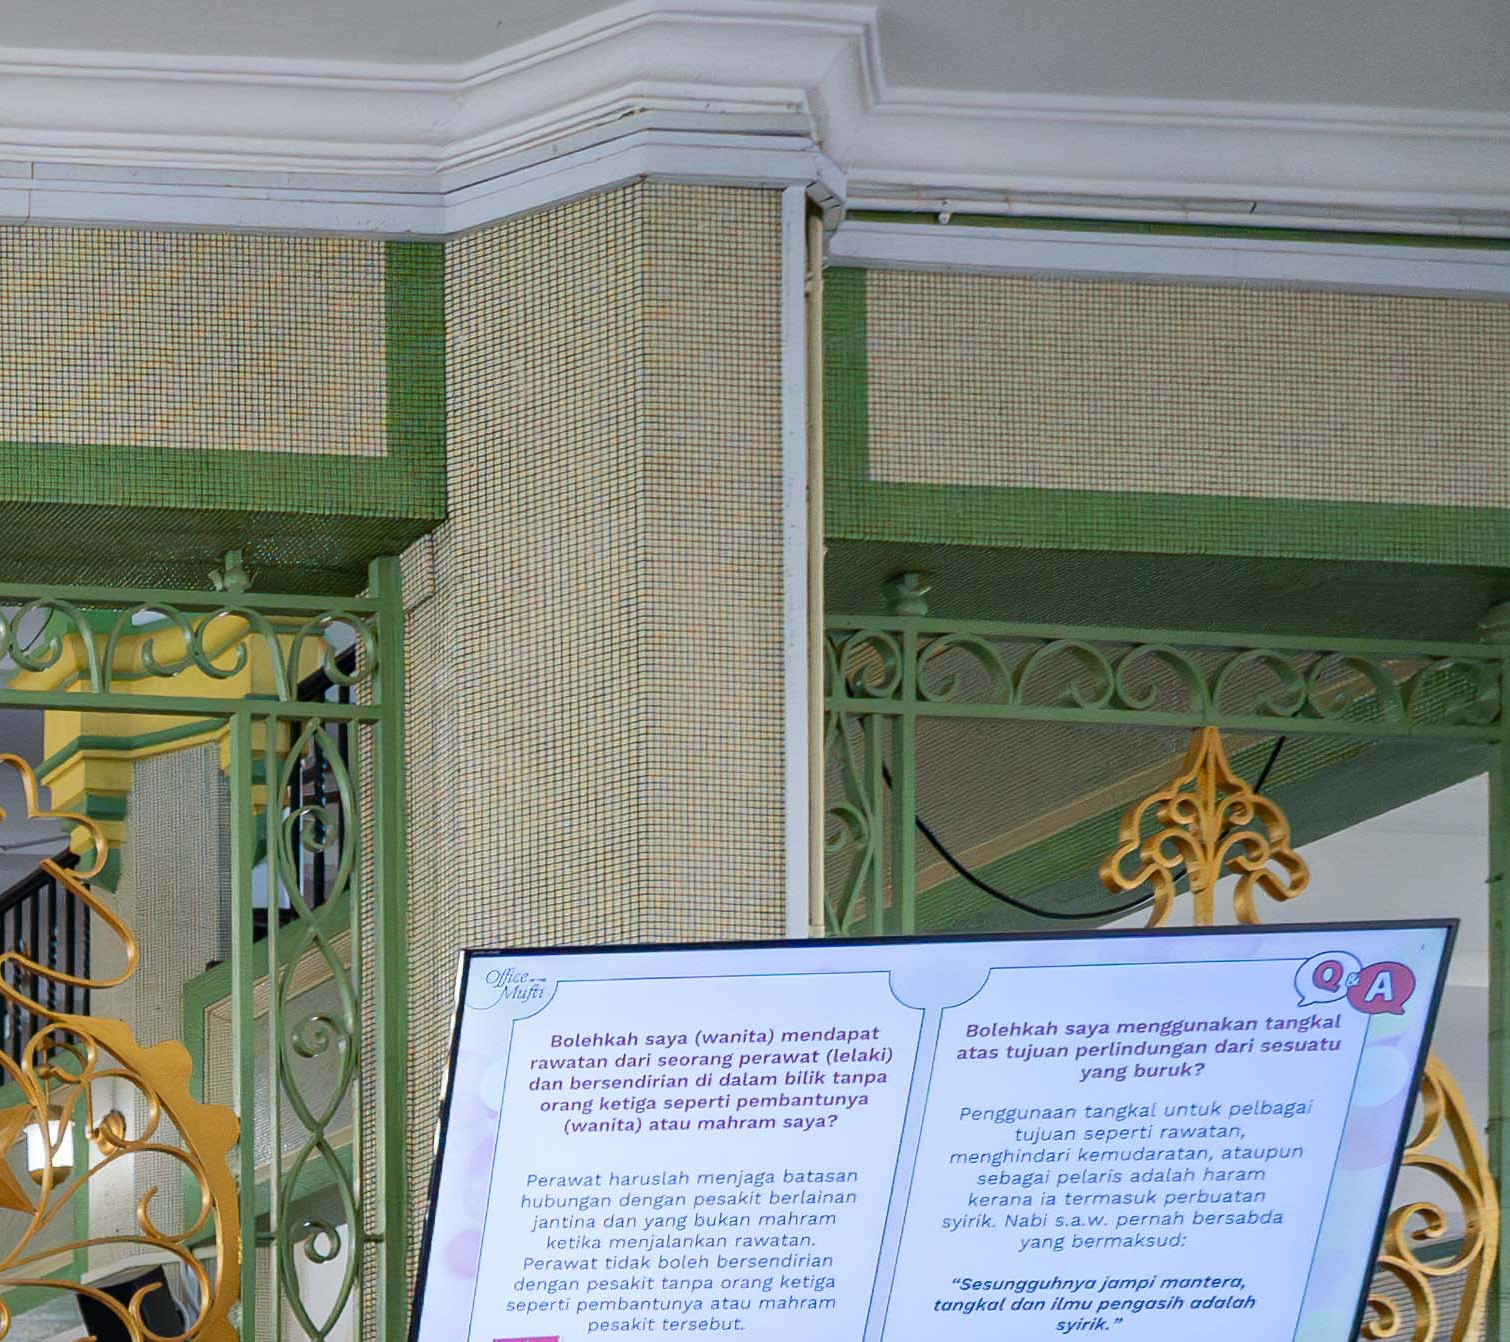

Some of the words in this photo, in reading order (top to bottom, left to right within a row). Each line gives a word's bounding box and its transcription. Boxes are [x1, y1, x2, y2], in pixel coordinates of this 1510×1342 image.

[966, 1020, 1058, 1038] Bolehkah
[1064, 1023, 1110, 1039] saya
[1116, 1016, 1258, 1037] menggunakan
[1265, 1013, 1342, 1034] tangkal
[550, 1031, 638, 1048] Bolehkah
[645, 1034, 688, 1049] saya
[781, 1026, 880, 1045] mendapat
[530, 1055, 608, 1070] rawatan
[614, 1052, 652, 1068] dari
[657, 1052, 734, 1069] seorang
[738, 1050, 820, 1069] perawat
[956, 1046, 999, 1060] atas
[1006, 1043, 1069, 1062] tujuan
[1074, 1040, 1208, 1061] perlindungan
[1214, 1037, 1255, 1054] dari
[1260, 1037, 1342, 1053] sesuatu
[529, 1076, 563, 1091] dan
[569, 1074, 689, 1090] bersendirian
[695, 1072, 713, 1087] di
[718, 1071, 778, 1087] dalam
[784, 1070, 826, 1086] bilik
[832, 1071, 887, 1088] tanpa
[1078, 1065, 1128, 1083] yang
[540, 1099, 594, 1115] orang
[599, 1095, 656, 1114] ketiga
[663, 1093, 731, 1113] seperti
[735, 1092, 869, 1112] pembantunya
[959, 1106, 1077, 1124] Penggunaan
[1084, 1102, 1157, 1122] tangkal
[1164, 1100, 1222, 1118] untuk
[1228, 1099, 1314, 1119] pelbagai
[649, 1118, 691, 1131] atau
[697, 1115, 776, 1131] mahram
[1015, 1127, 1076, 1145] tujuan
[1083, 1124, 1154, 1144] seperti
[949, 1147, 1072, 1168] menghindari
[1221, 1146, 1304, 1163] ataupun
[526, 1174, 602, 1187] Perawat
[608, 1170, 690, 1186] haruslah
[696, 1169, 775, 1188] menjaga
[783, 1168, 858, 1184] batasan
[976, 1170, 1051, 1189] sebagai
[1056, 1168, 1123, 1188] pelaris
[1129, 1167, 1195, 1183] adalah
[1202, 1167, 1266, 1182] haram
[521, 1193, 612, 1212] hubungan
[619, 1192, 686, 1210] dengan
[693, 1190, 762, 1209] pesakit
[769, 1189, 857, 1205] berlainan
[531, 1215, 595, 1233] jantina
[603, 1214, 637, 1229] dan
[643, 1215, 688, 1232] yang
[693, 1212, 751, 1227] bukan
[758, 1211, 836, 1226] mahram
[546, 1235, 601, 1250] ketika
[609, 1233, 727, 1252] menjalankan
[735, 1233, 815, 1248] rawatan.
[1097, 1275, 1158, 1294] jampi
[933, 1297, 1007, 1315] tangkal
[1010, 1297, 1046, 1311] dan
[1050, 1296, 1094, 1311] ilmu
[1096, 1295, 1184, 1314] pengasih
[1189, 1295, 1256, 1310] adalah
